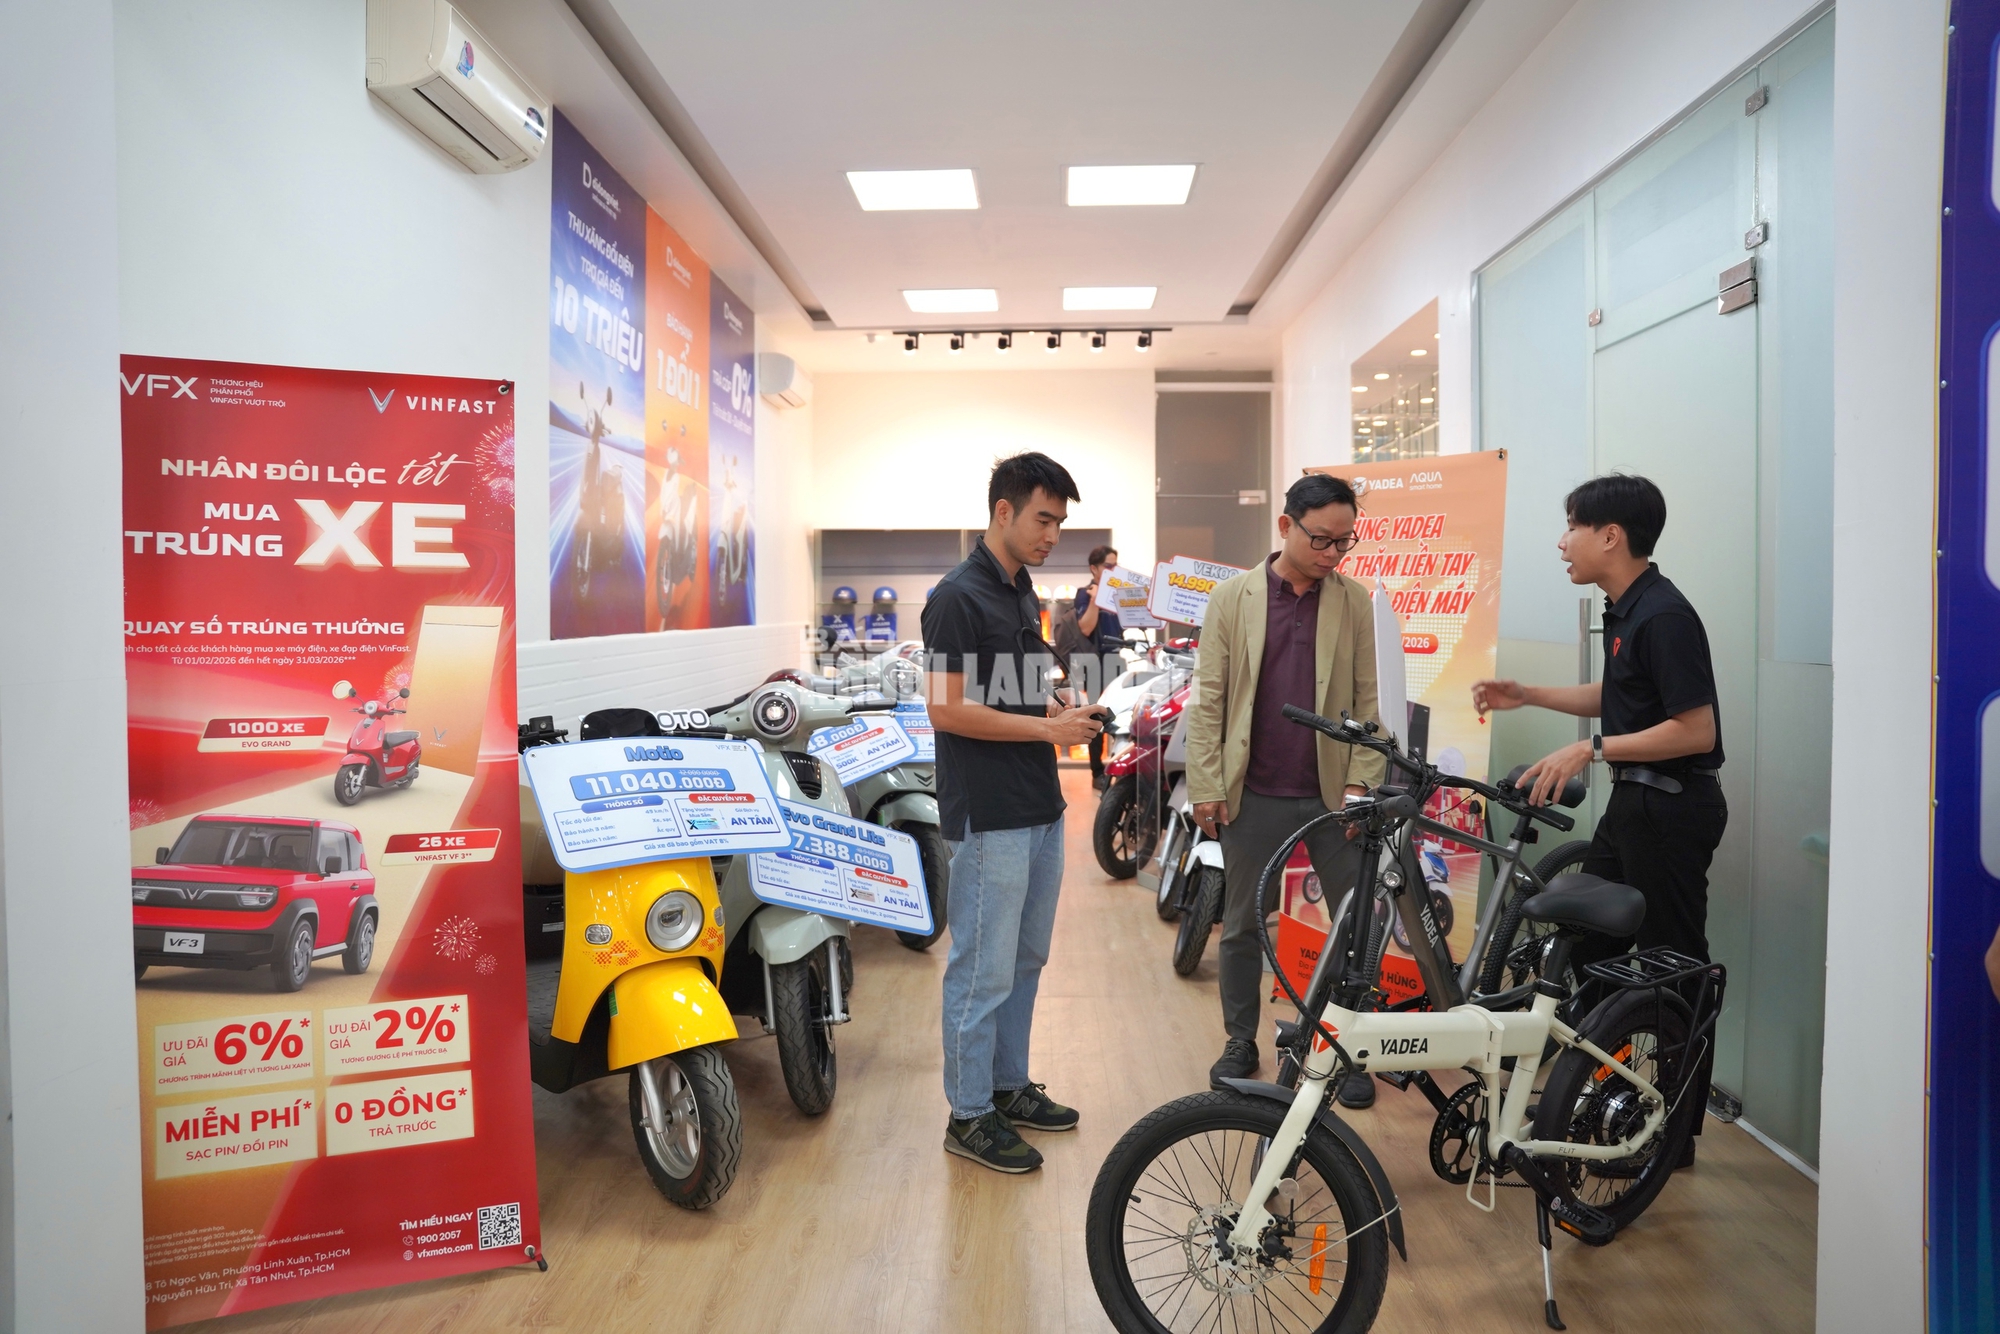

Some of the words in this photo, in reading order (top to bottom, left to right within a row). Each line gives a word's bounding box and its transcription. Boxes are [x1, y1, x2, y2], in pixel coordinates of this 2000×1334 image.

[568, 210, 585, 238] THU
[585, 225, 605, 255] XĂNG
[605, 240, 618, 265] ĐỔI
[618, 254, 635, 279] ĐIỆN
[581, 255, 596, 283] TRỢ
[554, 275, 579, 334] 10
[583, 294, 644, 375] TRIỆU
[656, 347, 664, 391] 1
[665, 342, 693, 404] ĐỔI
[119, 372, 199, 400] VFX
[210, 378, 245, 387] THƯƠNG
[245, 380, 264, 389] HIỆU
[210, 387, 233, 395] PHÂN
[234, 388, 254, 397] PHỐI
[731, 362, 752, 418] 0%
[210, 397, 243, 405] VINFAST
[244, 398, 266, 407] VƯỢT
[267, 400, 286, 408] TRỘI
[405, 395, 497, 416] VINFAST
[160, 455, 258, 480] NHÂN
[263, 459, 320, 483] ĐÔI
[327, 461, 387, 489] LỘC
[396, 451, 477, 488] tết
[1368, 477, 1404, 490] YADEA
[1409, 471, 1443, 484] AQUA
[1425, 482, 1443, 490] home
[203, 502, 280, 522] MUA
[124, 525, 284, 558] TRÚNG
[294, 498, 471, 569] XE
[1353, 508, 1390, 542] ÙNG
[1390, 512, 1447, 540] YADEA
[1352, 547, 1398, 578] THĂM
[1399, 540, 1439, 578] LIỀN
[1439, 550, 1477, 577] TAY
[1391, 581, 1431, 621] ĐIỆN
[1430, 582, 1478, 615] MÁY
[123, 620, 186, 637] QUAY
[189, 614, 223, 635] SỐ
[226, 618, 308, 635] TRÚNG
[311, 617, 405, 635] THƯỞNG
[136, 645, 153, 653] cho
[155, 644, 168, 653] tất
[170, 644, 181, 653] cả
[183, 644, 199, 653] các
[201, 644, 228, 653] khách
[229, 644, 252, 654] hàng
[287, 644, 306, 654] máy
[307, 644, 328, 654] điện,
[341, 644, 358, 654] đạp
[359, 644, 377, 654] điện
[378, 644, 412, 653] VinFast.
[171, 656, 183, 665] Từ
[185, 656, 236, 665] 01/02/2026
[238, 655, 255, 664] đến
[256, 656, 270, 664] hết
[272, 656, 294, 666] ngày
[228, 721, 279, 734] 1000
[282, 722, 305, 733] XE
[658, 710, 708, 729] OTO
[241, 740, 259, 749] EVO
[261, 739, 291, 748] GRAND
[624, 745, 684, 762] Motio
[867, 747, 880, 756] AN
[881, 738, 900, 750] TÂM
[835, 756, 860, 769] 500K
[603, 799, 633, 809] THÔNG
[633, 796, 644, 806] SỐ
[697, 795, 712, 803] ĐẶC
[712, 793, 735, 802] QUYỀN
[731, 816, 748, 825] AN
[748, 814, 774, 825] TÂM
[782, 807, 811, 825] Evo
[812, 814, 857, 839] Grand
[858, 826, 886, 847] Lite
[418, 836, 441, 849] 26
[444, 835, 467, 847] XE
[414, 853, 448, 863] VINFAST
[449, 853, 460, 861] VF
[884, 895, 898, 906] AN
[899, 897, 920, 910] TÂM
[1419, 903, 1438, 949] YADEA
[1387, 971, 1418, 990] HÙNG
[328, 1022, 350, 1036] ƯU
[350, 1018, 371, 1033] ĐÃI
[162, 1038, 184, 1053] ƯU
[186, 1035, 208, 1050] ĐÃI
[329, 1035, 351, 1050] GIÁ
[1380, 1037, 1429, 1056] YADEA
[162, 1052, 187, 1067] GIÁ
[341, 1055, 365, 1064] TƯƠNG
[366, 1053, 391, 1062] ĐƯƠNG
[392, 1051, 401, 1060] LỆ
[401, 1049, 413, 1058] PHÍ
[414, 1047, 437, 1057] TRƯỚC
[158, 1074, 189, 1084] CHƯƠNG
[190, 1071, 211, 1081] TRÌNH
[211, 1069, 233, 1079] MÃNH
[234, 1068, 247, 1078] LIỆT
[256, 1065, 280, 1075] TƯƠNG
[280, 1064, 291, 1072] LAI
[291, 1062, 311, 1071] XANH
[334, 1101, 353, 1124] 0
[165, 1105, 240, 1144] MIỄN
[369, 1125, 394, 1138] TRẢ
[396, 1119, 437, 1135] TRƯỚC
[185, 1148, 212, 1162] SẠC
[215, 1144, 240, 1157] PIN/
[242, 1138, 266, 1153] ĐỔI
[268, 1138, 289, 1149] PIN
[1558, 1146, 1576, 1154] FLIT
[399, 1219, 418, 1231] TÌM
[419, 1213, 443, 1228] HIỂU
[444, 1211, 474, 1225] NGAY
[416, 1233, 439, 1245] 1900
[439, 1230, 462, 1242] 2057
[417, 1242, 473, 1259] vfxmoto.com
[169, 1275, 197, 1287] Ngọc
[198, 1270, 220, 1282] Vân,
[222, 1263, 262, 1277] Phường
[263, 1259, 285, 1270] Linh
[286, 1255, 313, 1267] Xuân,
[314, 1248, 351, 1261] Tp.HCM
[152, 1288, 193, 1304] Nguyễn
[195, 1284, 217, 1295] Hữu
[235, 1278, 248, 1288] Xã
[249, 1274, 268, 1285] Tân
[270, 1270, 297, 1283] Nhựt,
[298, 1263, 335, 1278] Tp.HCM
